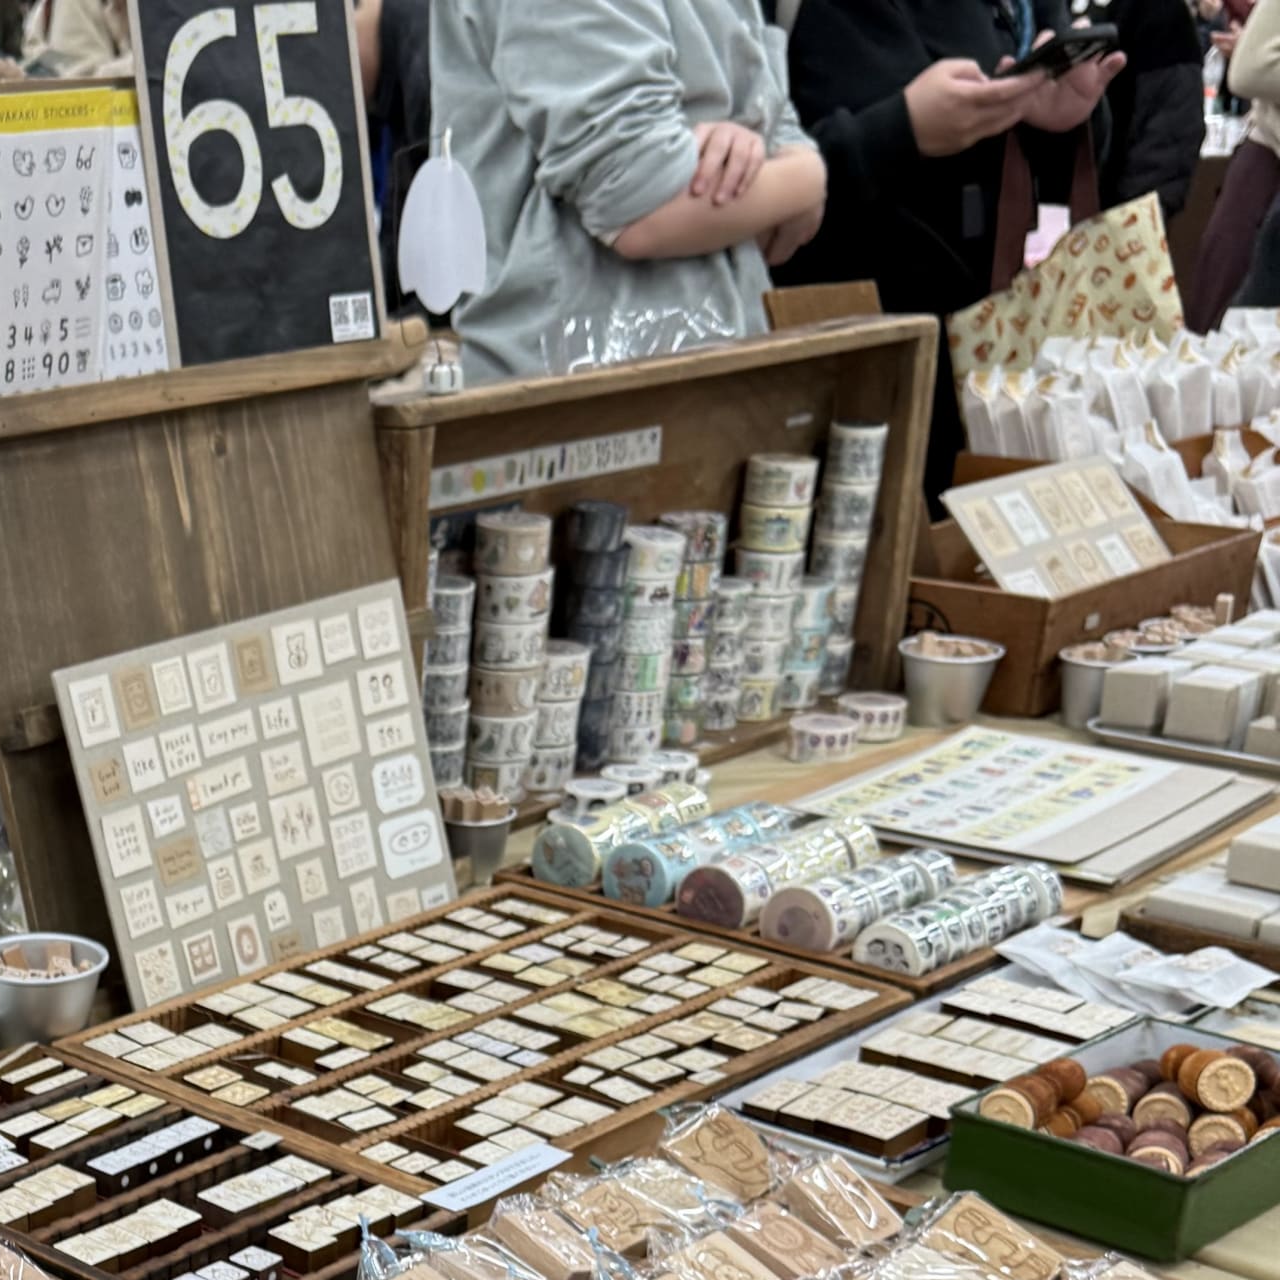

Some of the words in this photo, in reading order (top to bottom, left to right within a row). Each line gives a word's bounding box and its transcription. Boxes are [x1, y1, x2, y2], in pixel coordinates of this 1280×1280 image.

[43, 106, 88, 119] STICKERS
[164, 1, 342, 239] 65
[60, 317, 68, 341] 5
